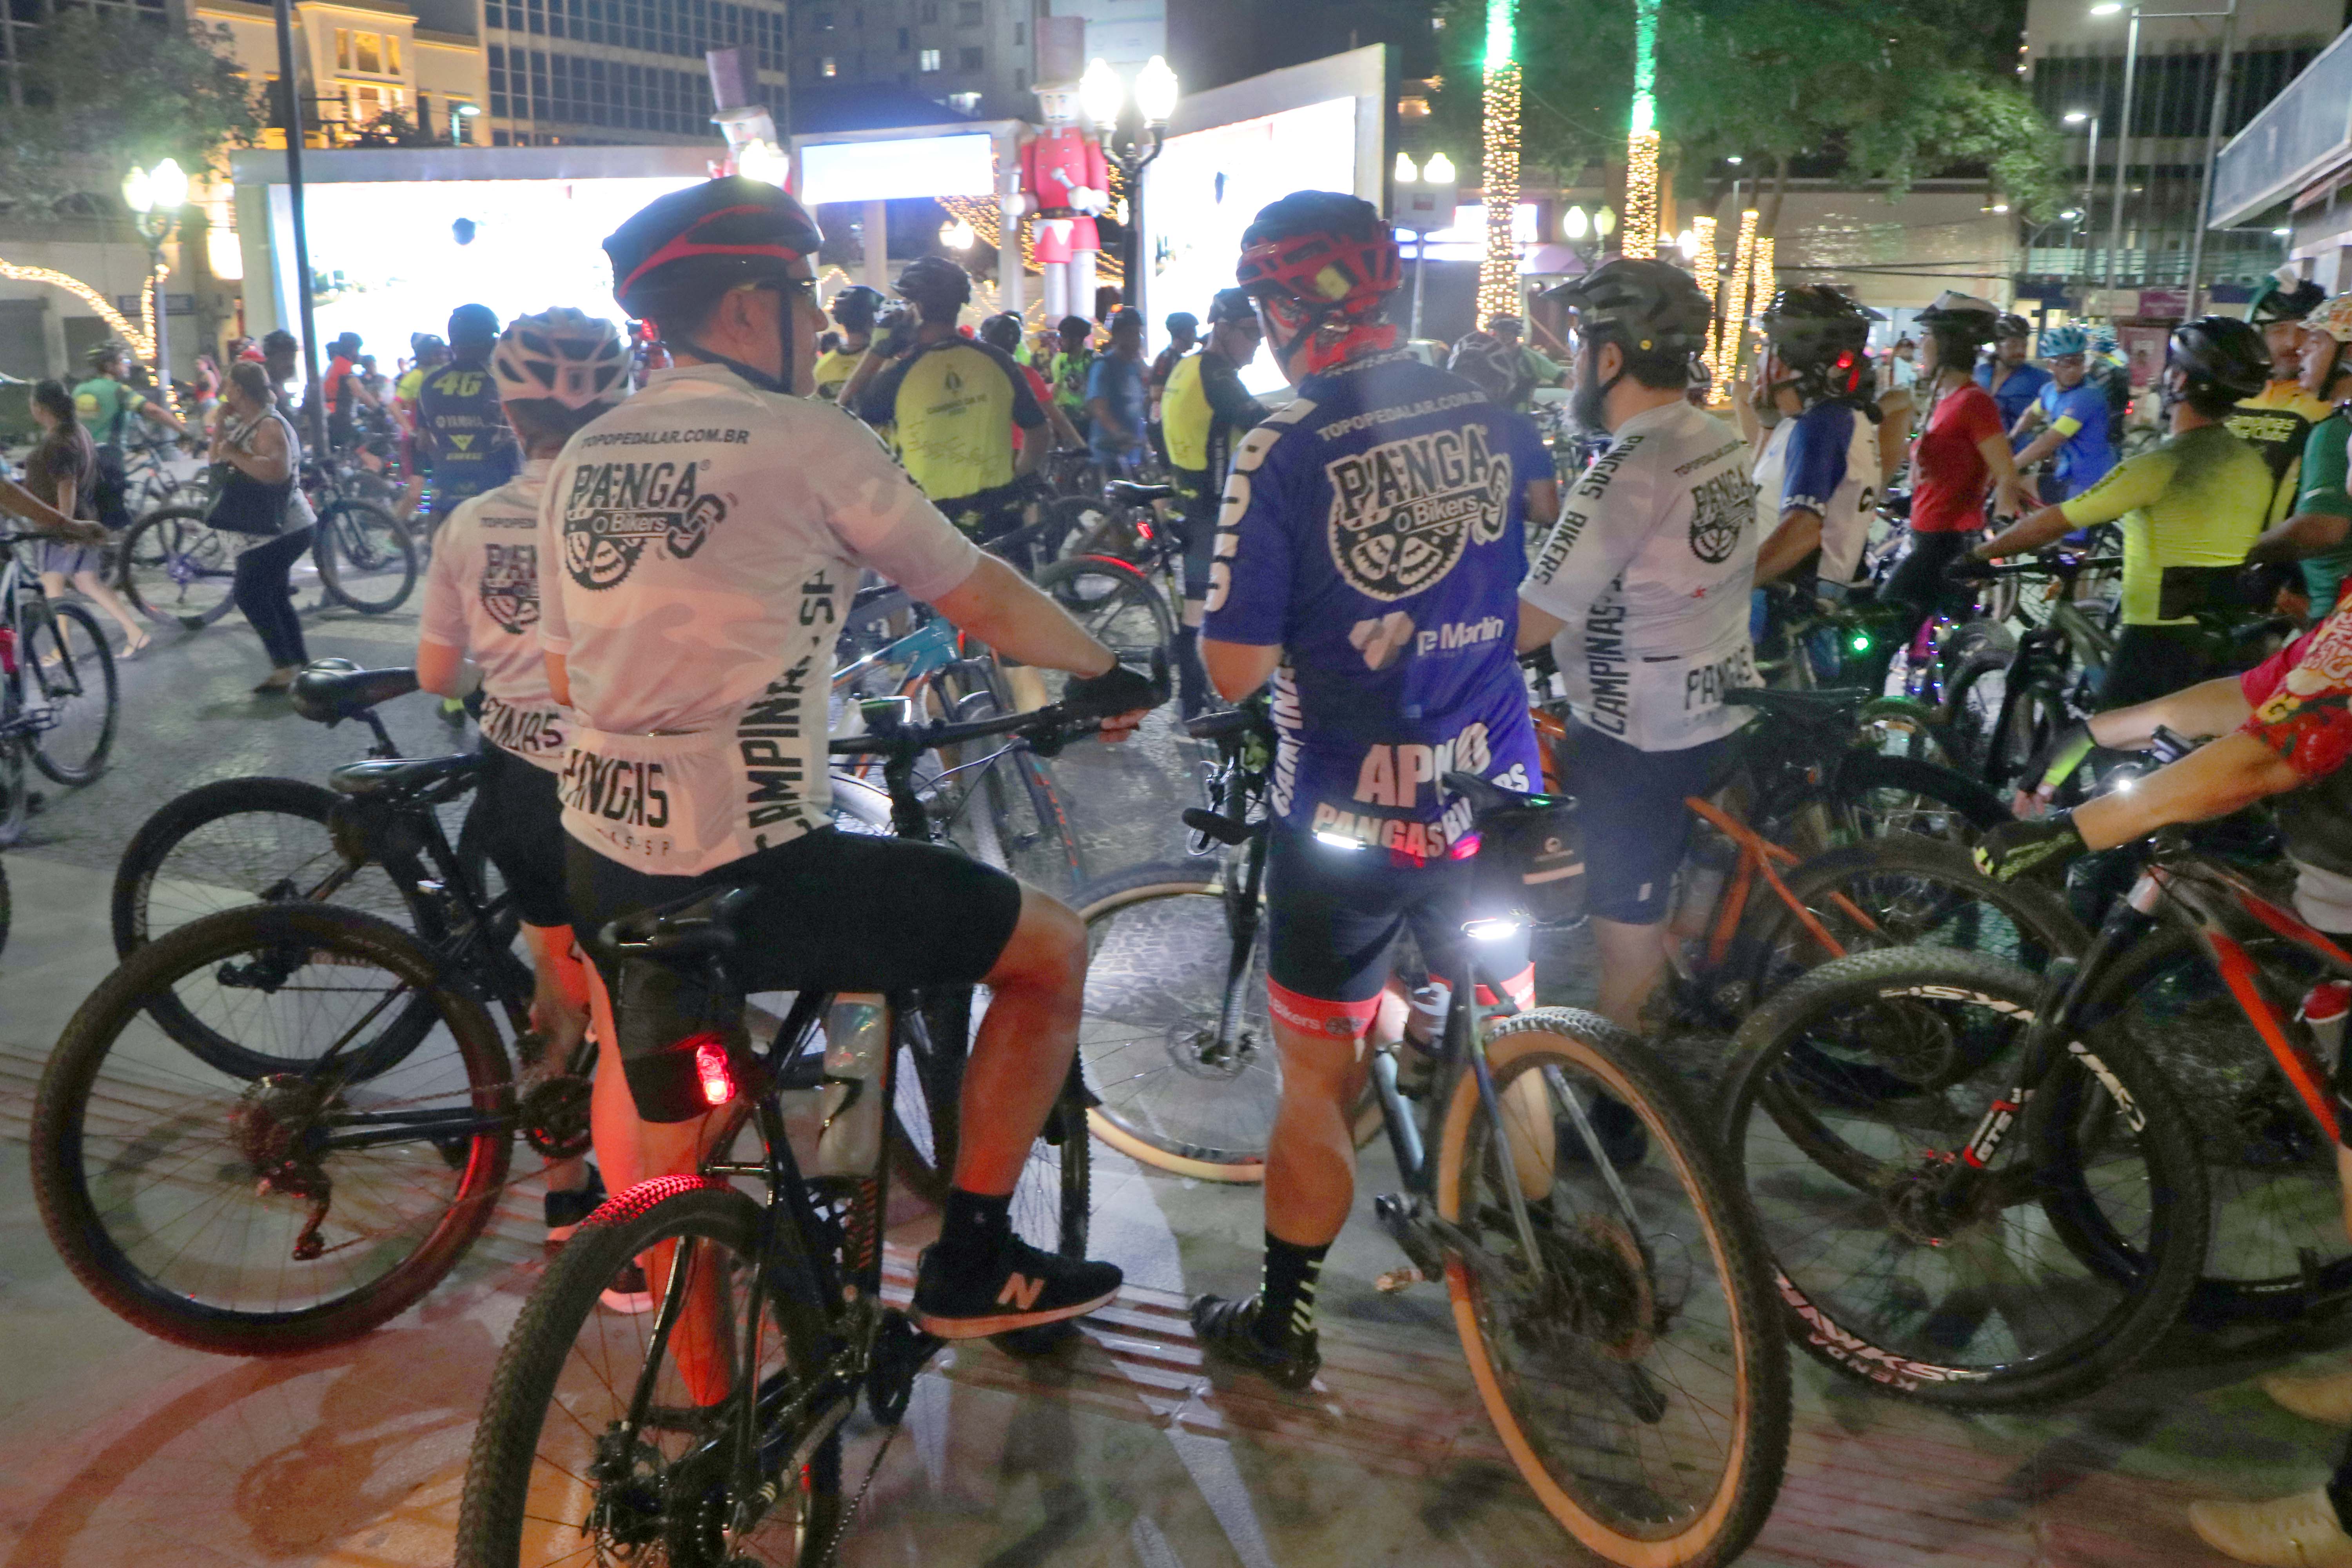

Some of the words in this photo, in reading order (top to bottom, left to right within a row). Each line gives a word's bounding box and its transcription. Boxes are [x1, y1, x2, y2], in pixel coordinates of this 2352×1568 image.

[433, 370, 486, 397] 46
[610, 512, 668, 534] Bikers
[1414, 495, 1478, 528] Bikers
[1533, 510, 1589, 585] BIKERS
[1440, 615, 1504, 649] Martin
[1584, 606, 1628, 736] CAMPINAS
[996, 1271, 1044, 1310] N
